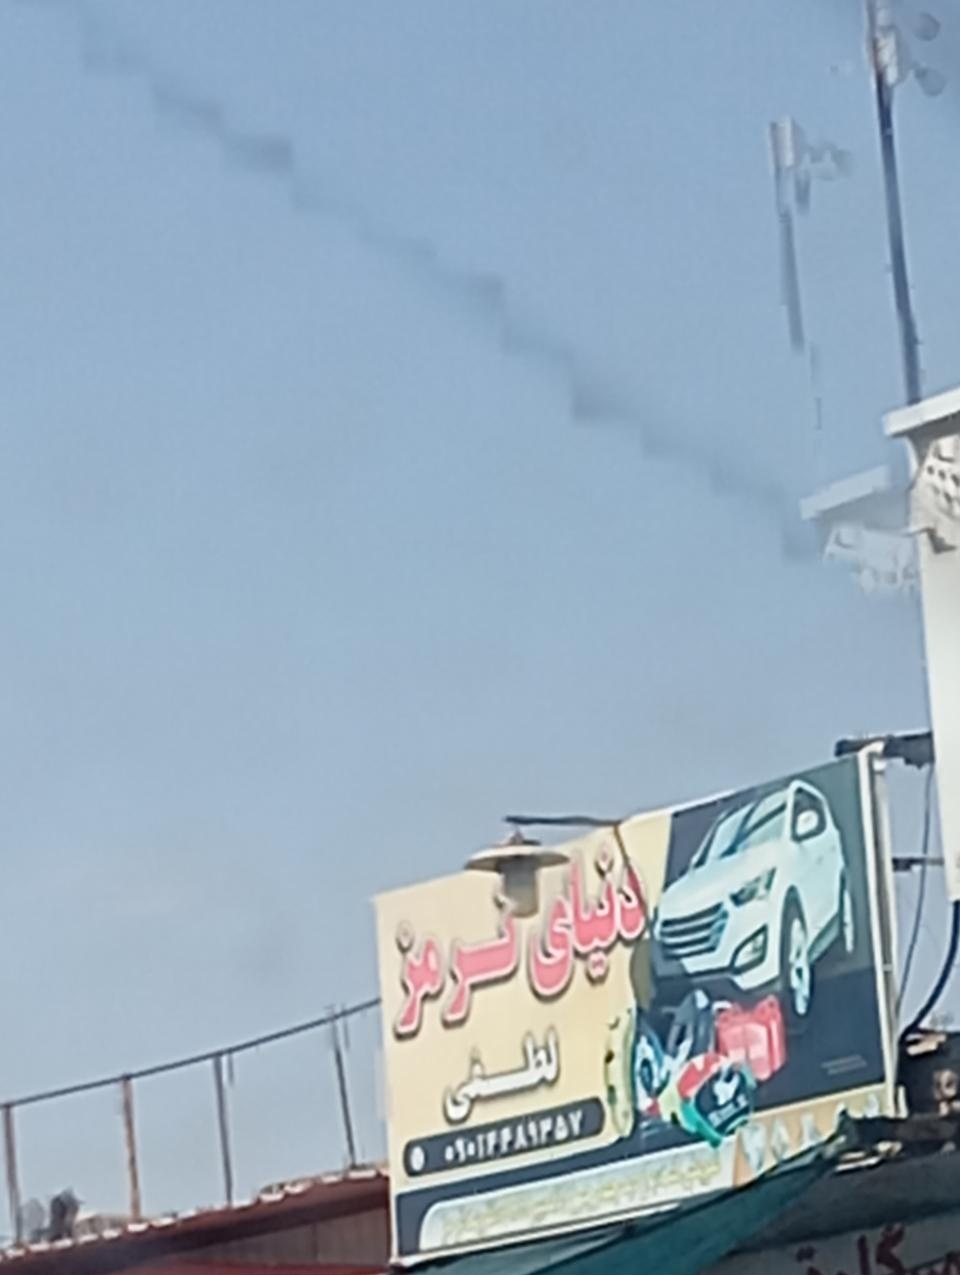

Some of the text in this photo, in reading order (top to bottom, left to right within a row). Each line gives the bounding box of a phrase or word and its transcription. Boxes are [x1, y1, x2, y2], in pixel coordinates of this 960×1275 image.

[394, 850, 648, 1041] دنیای ترمز
[443, 1024, 561, 1126] لطفی
